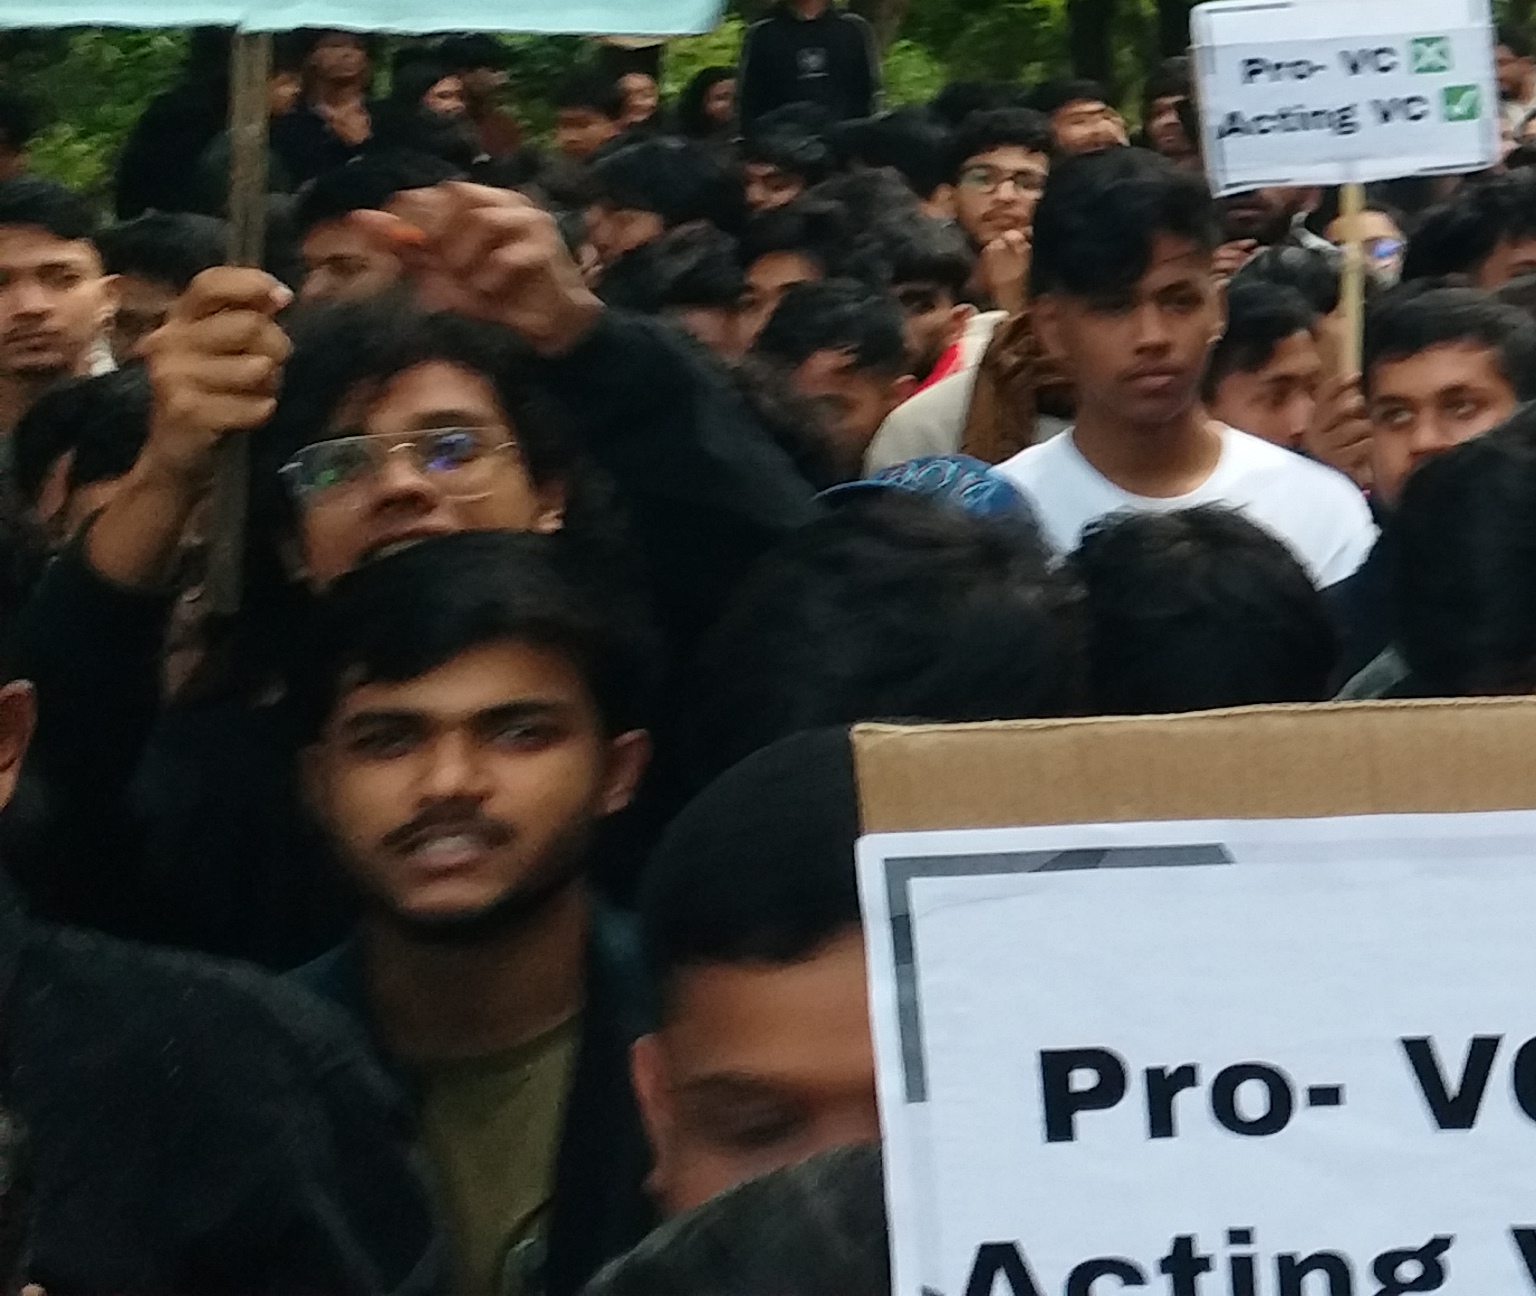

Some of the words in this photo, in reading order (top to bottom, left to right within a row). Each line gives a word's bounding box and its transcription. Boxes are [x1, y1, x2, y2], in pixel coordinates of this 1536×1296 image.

[1241, 57, 1326, 84] Pro-
[1339, 47, 1397, 76] VC
[1216, 104, 1359, 139] Acting
[1371, 95, 1429, 123] VC
[1039, 1046, 1346, 1142] Pro-
